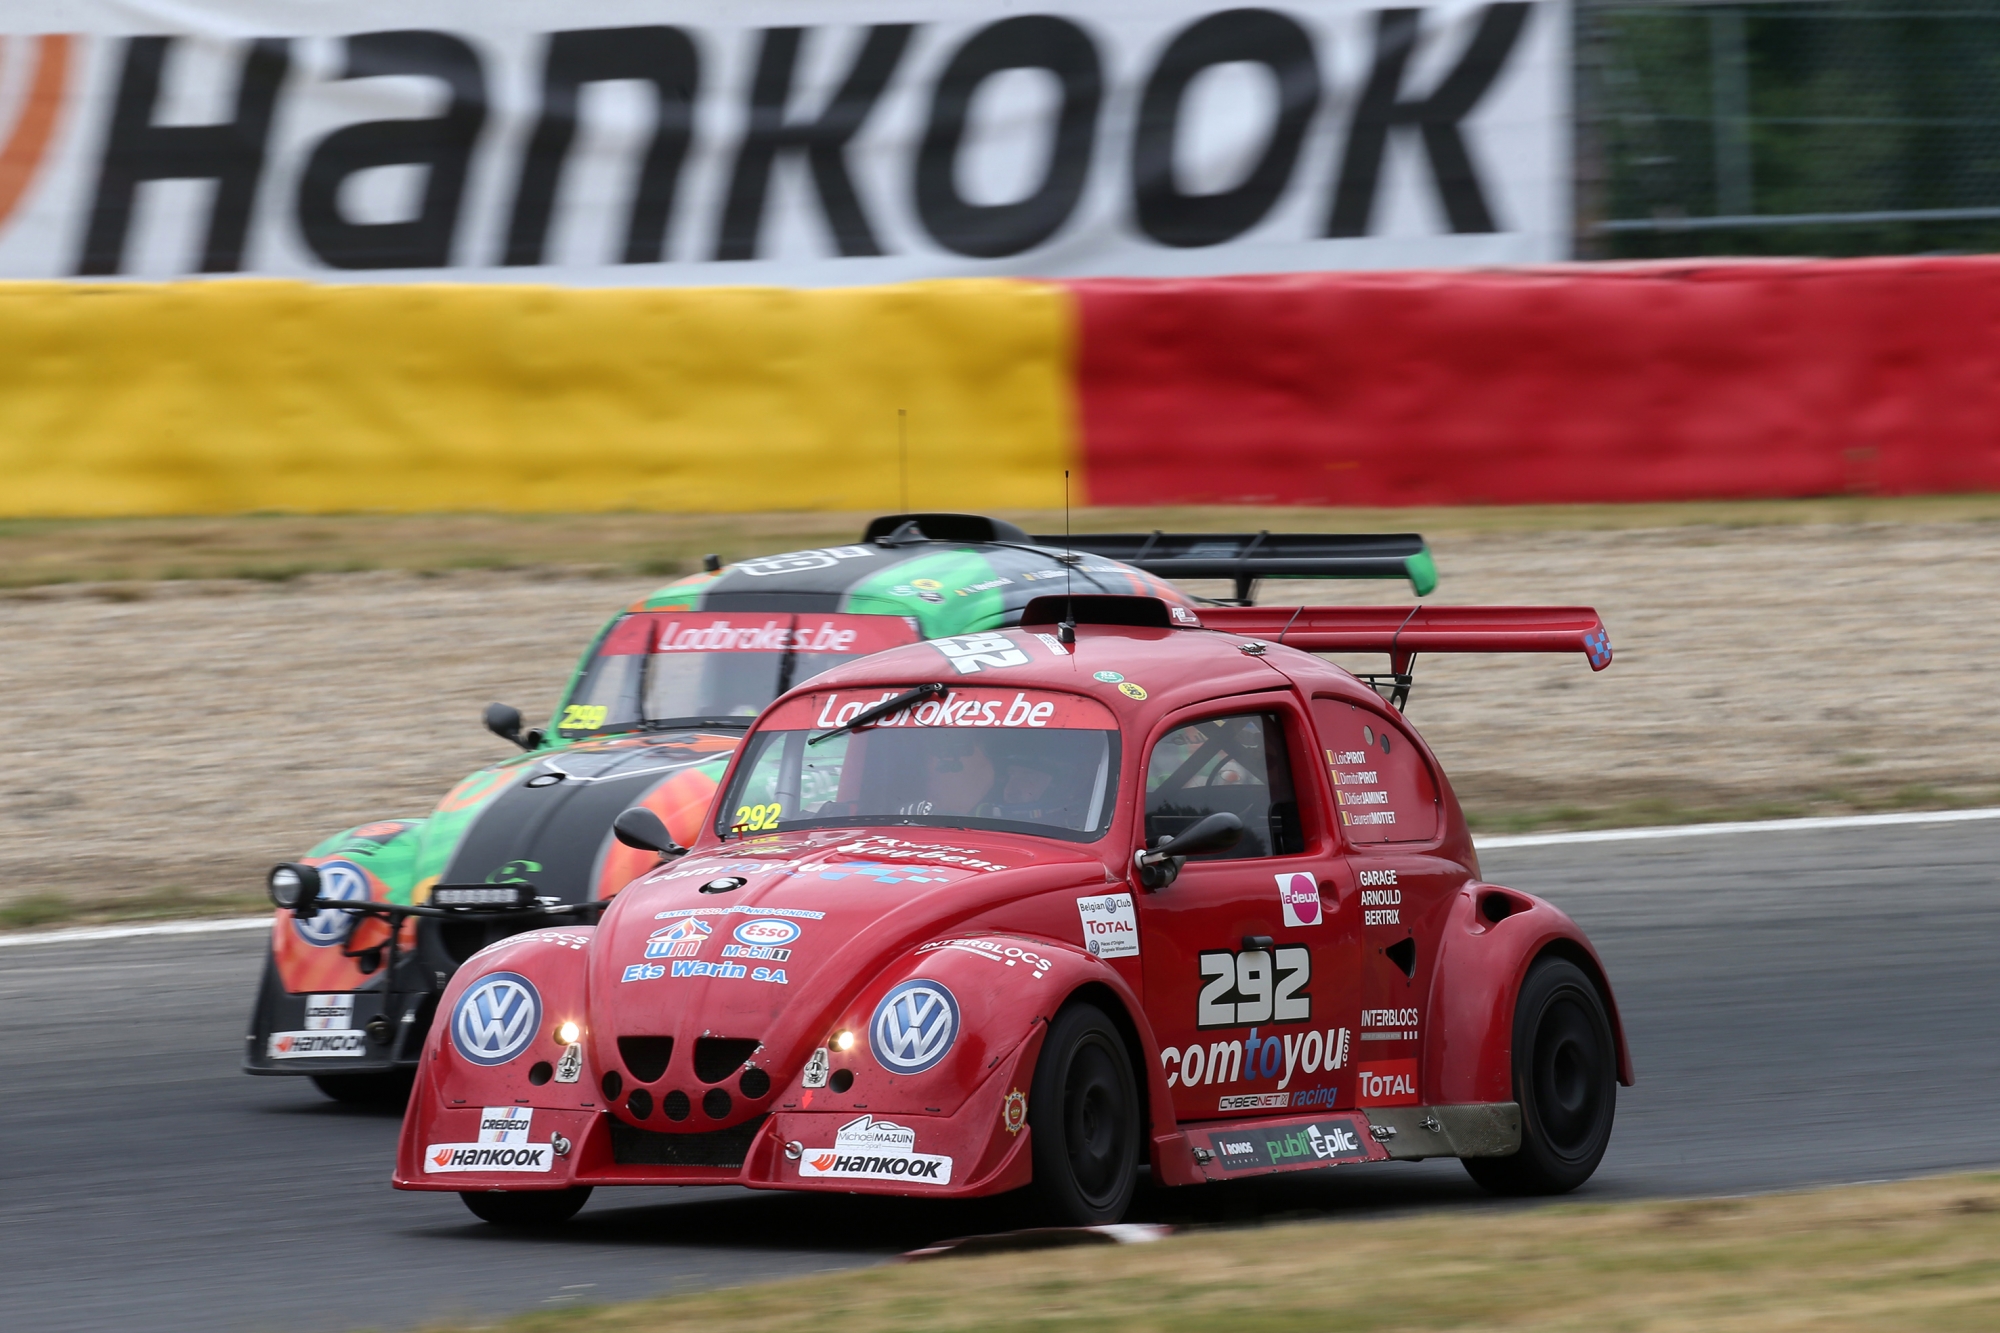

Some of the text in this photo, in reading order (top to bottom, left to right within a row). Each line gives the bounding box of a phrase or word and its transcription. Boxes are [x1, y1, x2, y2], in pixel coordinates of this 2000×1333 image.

[658, 620, 858, 651] Ladbrokes.be
[731, 802, 782, 833] 292
[1360, 870, 1398, 886] GARAGE
[1080, 901, 1105, 912] Belgian
[1116, 898, 1131, 908] Club
[1361, 889, 1401, 906] ARNOULD
[656, 909, 694, 919] CENTRE
[1365, 909, 1400, 925] BERTRIX
[722, 945, 769, 959] Mobil
[920, 939, 1052, 971] INTERBLOCS
[622, 964, 665, 982] Ets
[672, 961, 746, 978] Warin
[1198, 947, 1310, 1026] 292
[1360, 1008, 1419, 1027] INTERBLOCS
[1160, 1028, 1346, 1091] comtoyou
[1220, 1085, 1338, 1109] CYBERNET racing
[481, 1119, 529, 1130] CREDECO
